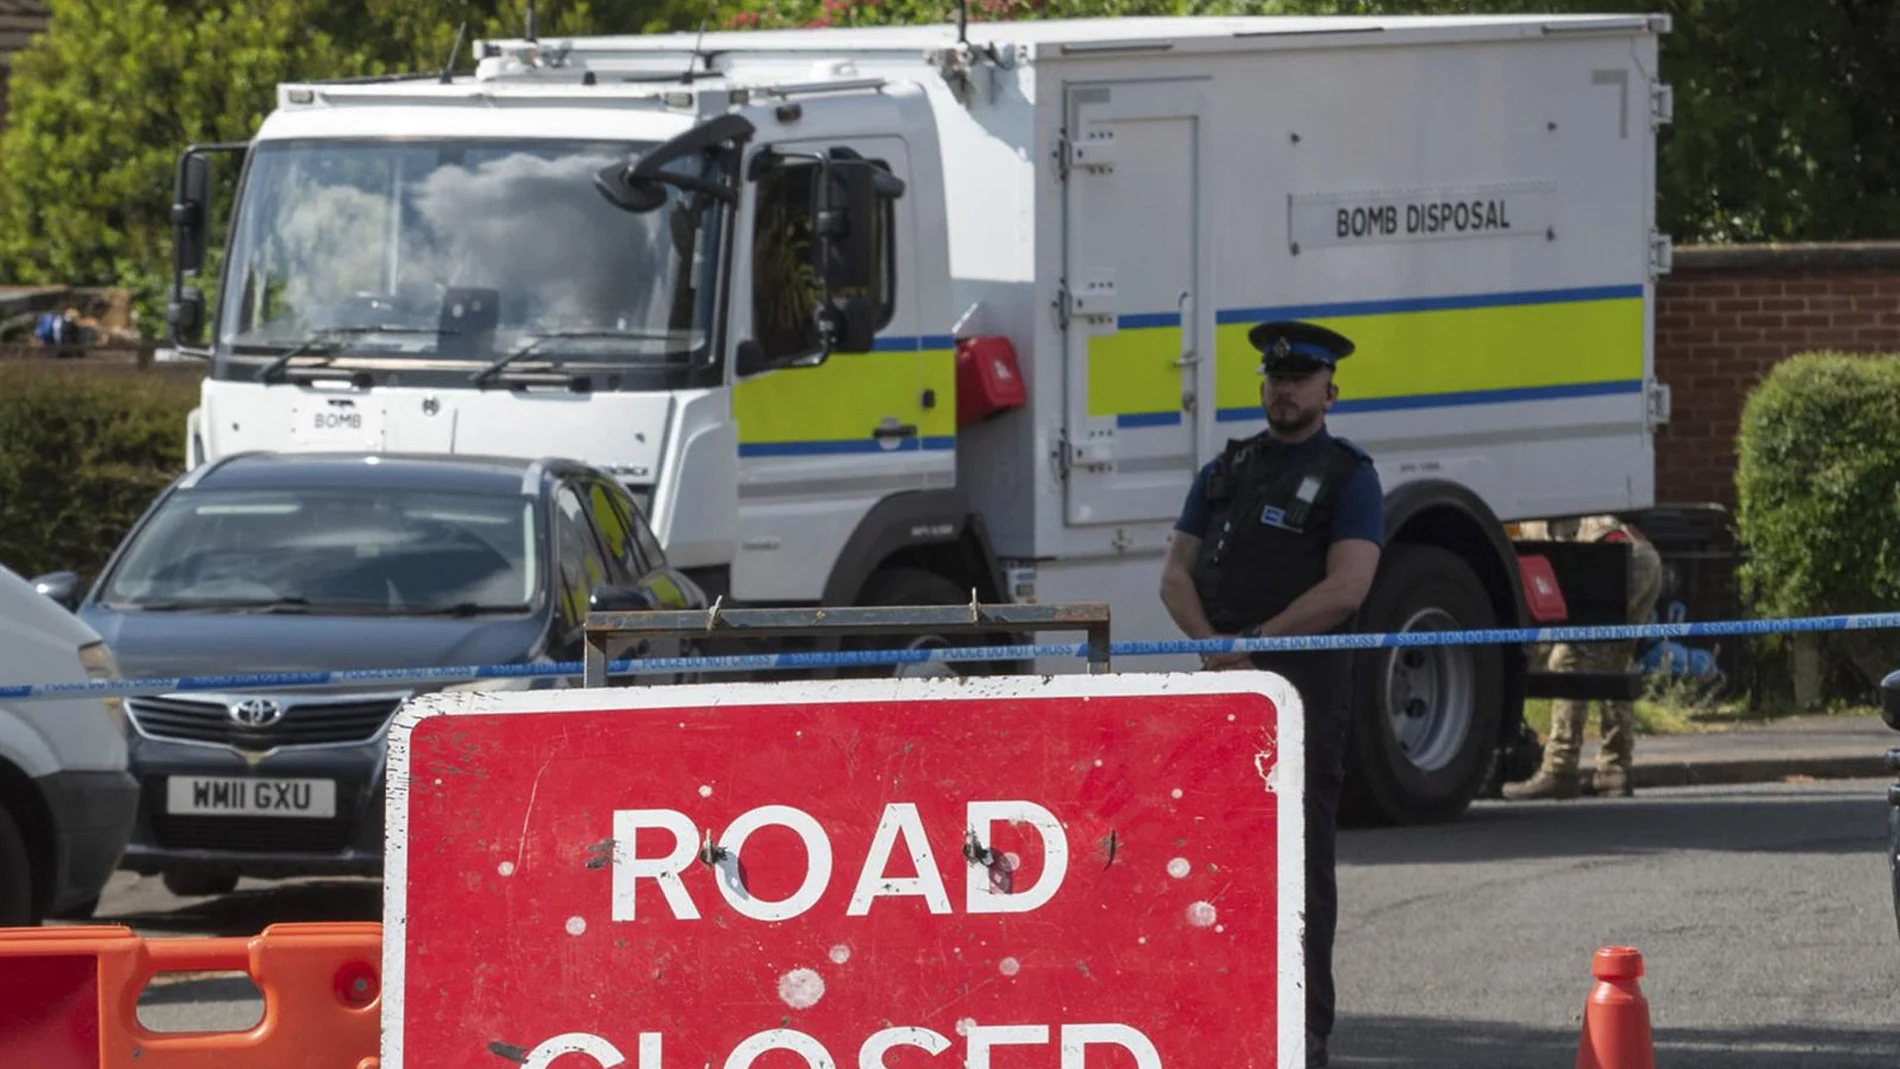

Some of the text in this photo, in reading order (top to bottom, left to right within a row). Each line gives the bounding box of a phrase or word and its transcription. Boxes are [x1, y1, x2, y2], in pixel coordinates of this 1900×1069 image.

[1336, 200, 1511, 238] BOMB DISPOSAL
[314, 413, 362, 428] BOMB
[1245, 637, 1287, 650] POLICE
[1396, 629, 1528, 645] POLICE DO NOT CROSS
[942, 644, 1073, 659] POLICE DO NOT CROSS
[193, 781, 311, 810] WM11 GXU
[611, 800, 1069, 922] ROAD
